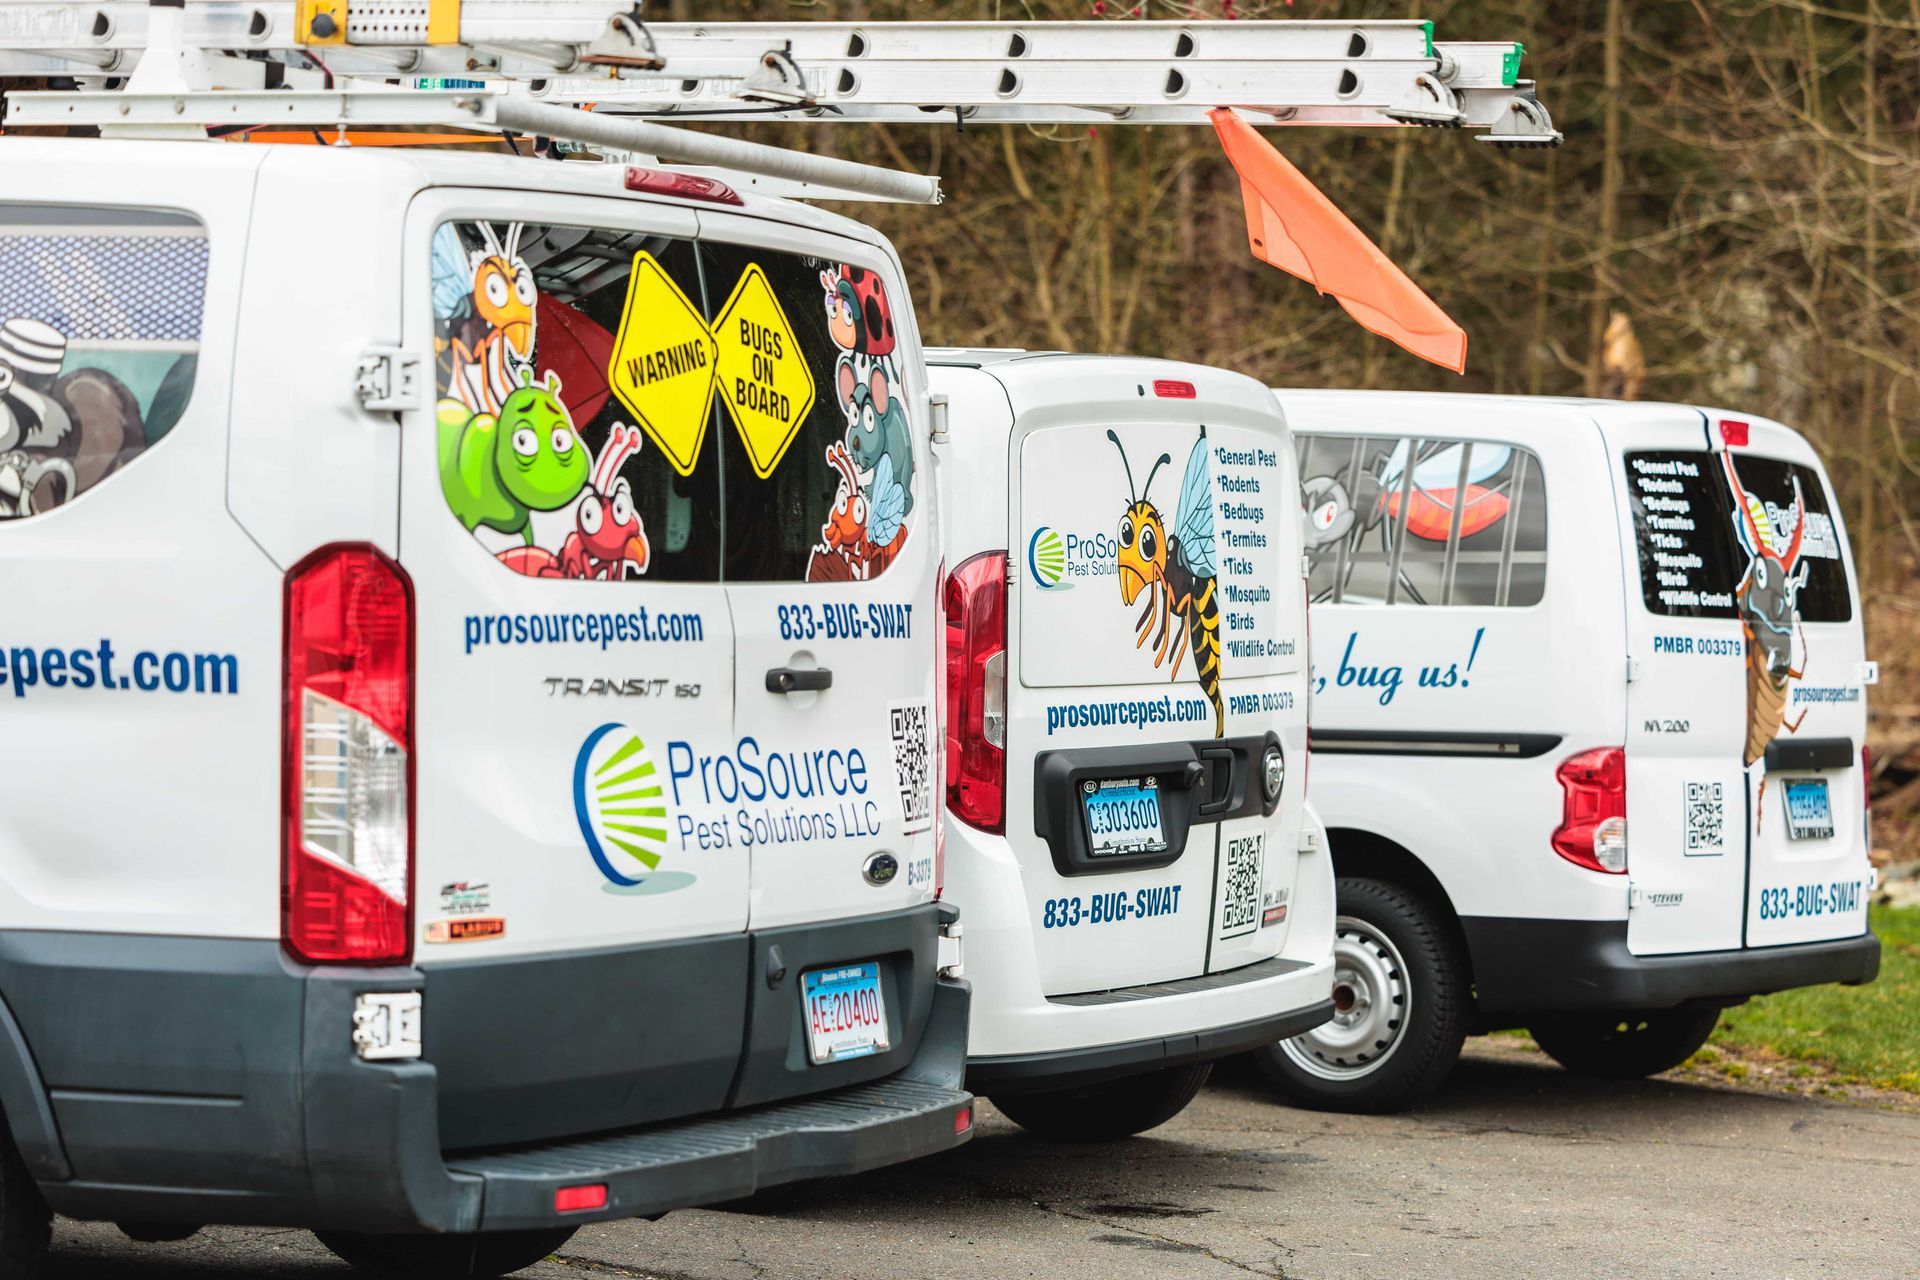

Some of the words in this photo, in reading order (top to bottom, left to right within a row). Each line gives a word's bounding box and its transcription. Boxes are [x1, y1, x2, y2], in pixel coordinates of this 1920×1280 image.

[739, 317, 783, 360] BUGS
[626, 338, 707, 388] WARNING
[752, 353, 774, 387] ON
[736, 377, 790, 423] BOARD
[1258, 450, 1277, 467] Pest
[1068, 561, 1089, 576] Pest
[1700, 590, 1733, 607] Control
[464, 605, 703, 654] prosourcepest.com
[778, 603, 912, 640] 833-BUG-SWAT
[1267, 637, 1295, 657] Control
[1654, 636, 1694, 654] PMBR
[1697, 638, 1741, 656] 003379
[0, 638, 238, 697] pest.com
[1336, 631, 1403, 706] bug
[1418, 627, 1486, 688] us!
[543, 676, 669, 697] TRANSIT
[674, 684, 701, 698] 150
[1229, 694, 1260, 716] PMBR
[1262, 691, 1294, 711] 003379
[1047, 696, 1207, 735] prosourcepest.com
[666, 736, 869, 806] ProSource
[677, 813, 733, 851] Pest
[737, 806, 837, 847] Solutions
[839, 800, 881, 838] LLC
[1043, 884, 1182, 929] 833-BUG-SWAT
[1760, 881, 1862, 920] 833-BUG-SWAT
